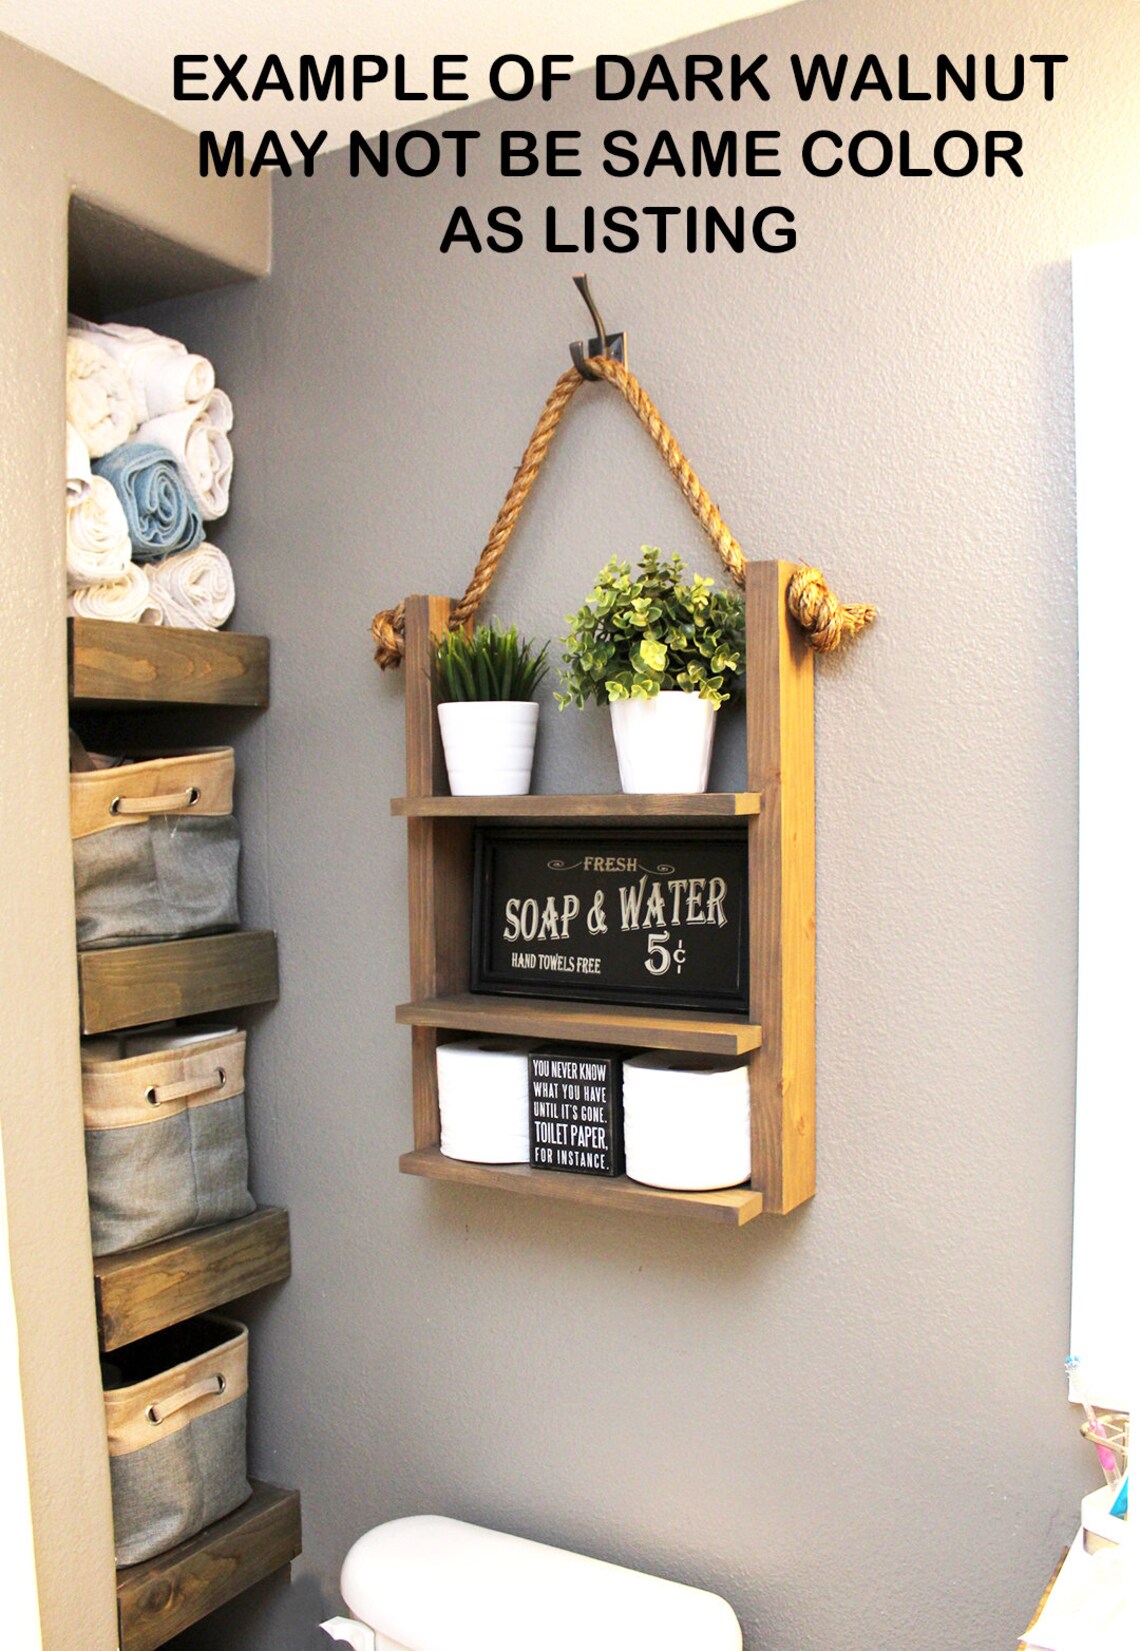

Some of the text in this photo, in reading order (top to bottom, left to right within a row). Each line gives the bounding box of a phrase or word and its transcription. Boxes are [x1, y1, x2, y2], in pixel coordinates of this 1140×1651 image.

[583, 857, 638, 872] FRESH
[503, 874, 728, 942] SOAP & WATER
[511, 952, 601, 974] HAND TOWELS FREE
[532, 1059, 607, 1082] YOU NEVER KNOW
[533, 1081, 607, 1103] WHAT YOU HAVE
[533, 1101, 608, 1124] UNTIL IT'S GONE.
[534, 1121, 609, 1151] TOILET PAPER,
[534, 1147, 610, 1170] FOR INSTANCE.
